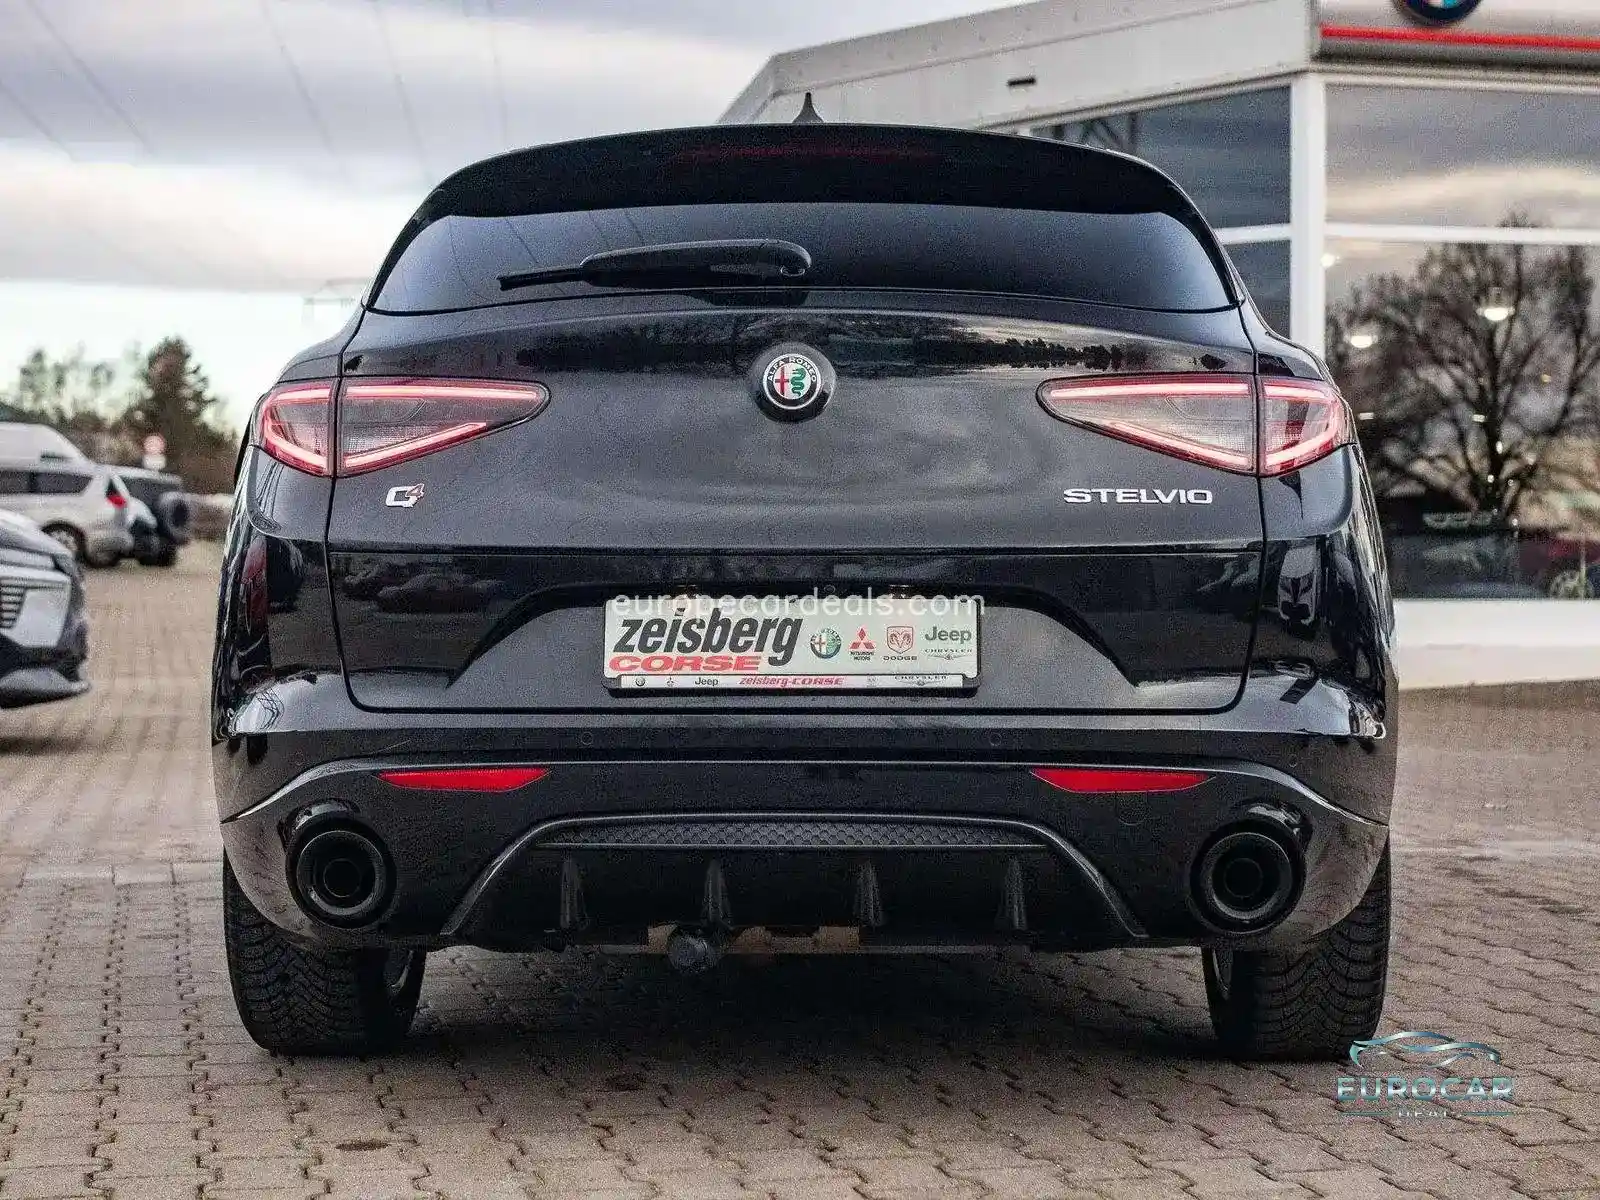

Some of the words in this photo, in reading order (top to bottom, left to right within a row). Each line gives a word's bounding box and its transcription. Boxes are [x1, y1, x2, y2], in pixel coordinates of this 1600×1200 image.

[767, 360, 785, 382] ALFA
[788, 356, 817, 382] ROMEO
[1063, 488, 1213, 504] STELVIO
[612, 606, 803, 667] zeisberg
[924, 625, 972, 645] Jeep
[608, 655, 762, 672] CORSE
[694, 677, 719, 687] Jeep
